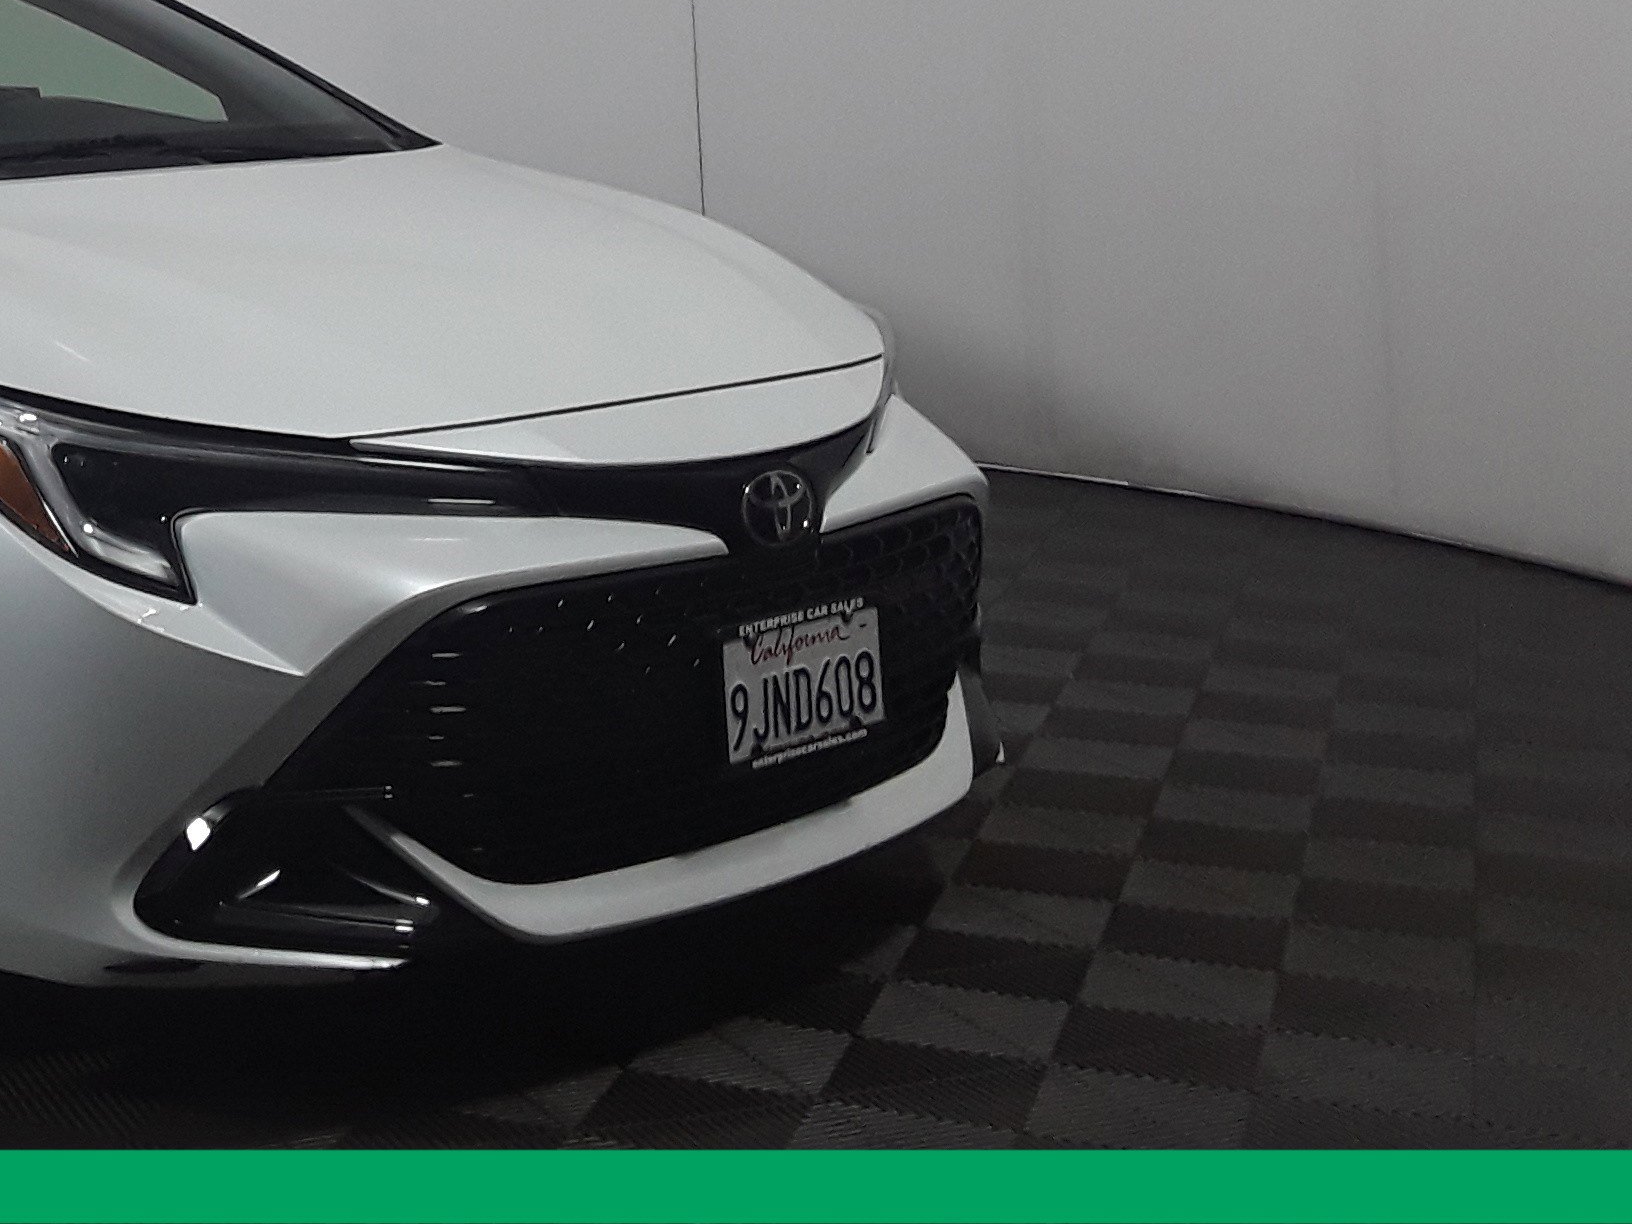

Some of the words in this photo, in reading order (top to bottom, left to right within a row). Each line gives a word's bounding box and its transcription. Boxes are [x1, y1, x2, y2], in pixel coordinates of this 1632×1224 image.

[739, 610, 805, 637] ENTERPRISE
[807, 605, 828, 620] CAR
[830, 597, 864, 615] SALES
[750, 626, 850, 665] California
[730, 650, 877, 752] 9JND608
